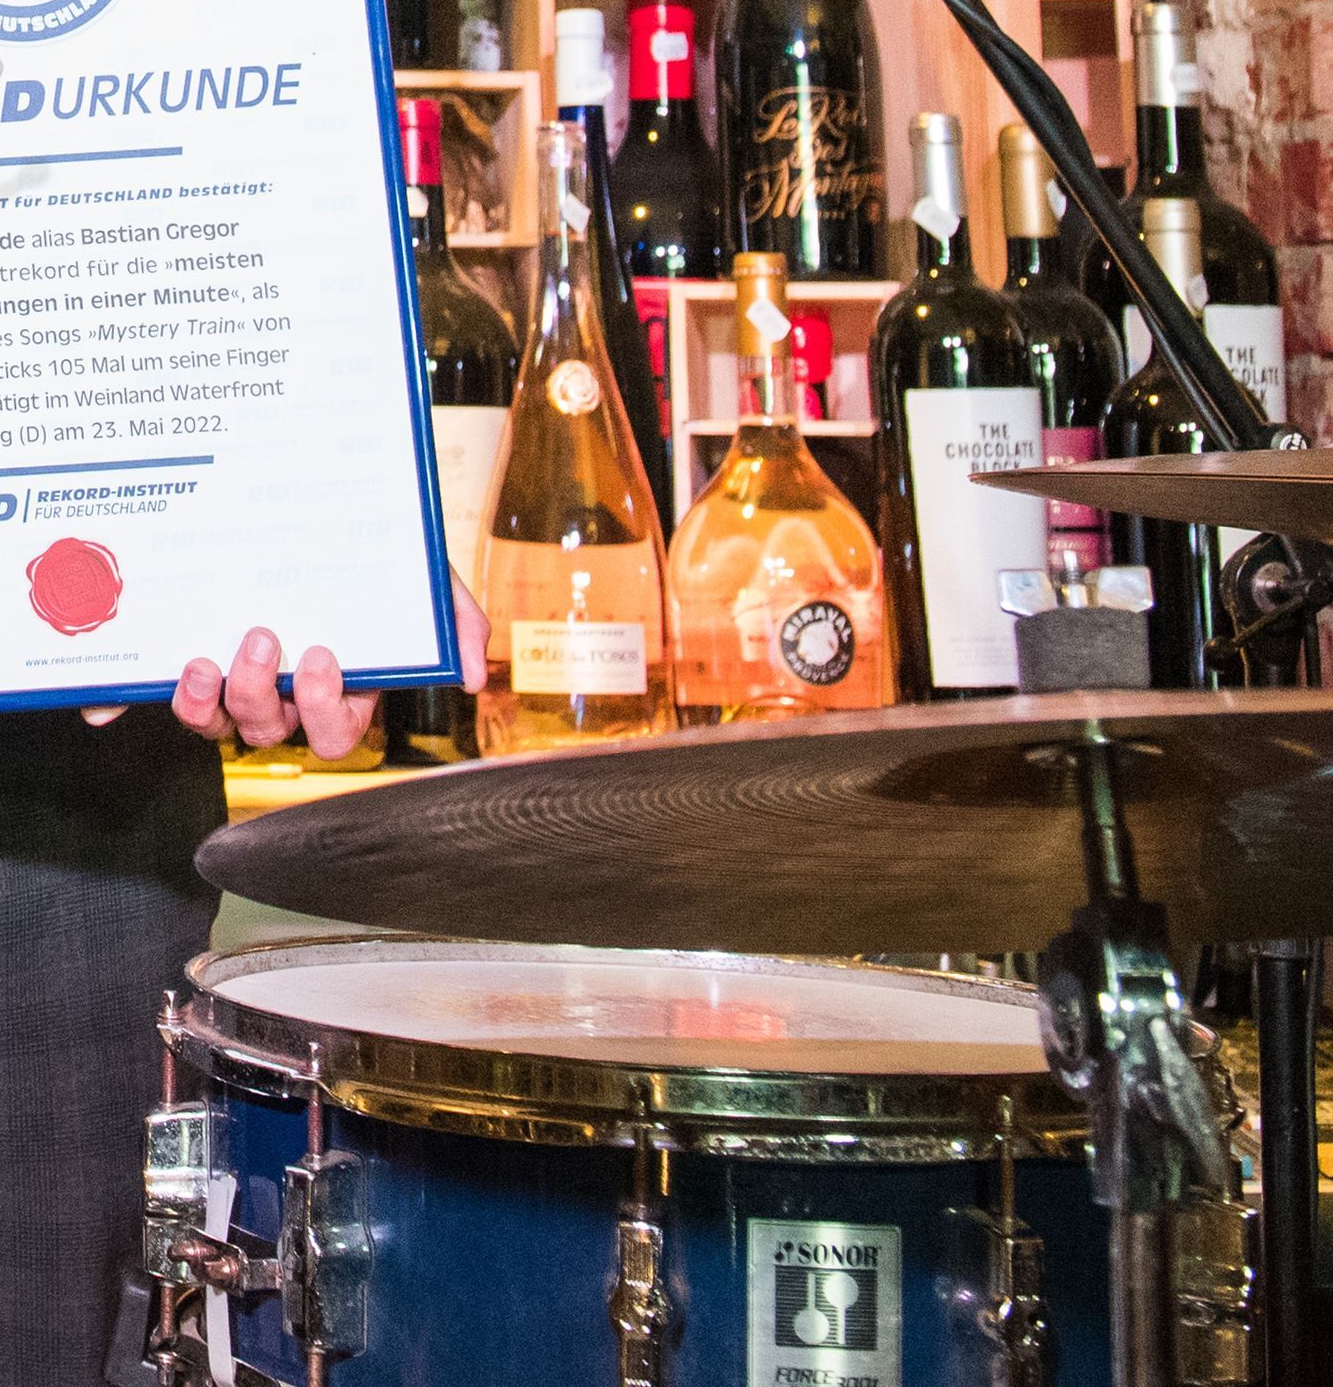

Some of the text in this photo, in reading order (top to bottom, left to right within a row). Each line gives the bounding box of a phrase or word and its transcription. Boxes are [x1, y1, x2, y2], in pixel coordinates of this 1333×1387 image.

[14, 196, 43, 209] für
[47, 187, 173, 206] DEUTSCHLAND
[178, 181, 273, 198] bestätigt:
[31, 229, 76, 249] alias
[80, 224, 160, 246] Bastian
[165, 222, 240, 241] Gregor
[86, 259, 120, 277] für
[126, 256, 158, 275] die
[64, 293, 84, 311] in
[90, 291, 147, 310] einer
[252, 281, 280, 300] als
[19, 328, 82, 347] Songs
[252, 316, 291, 332] von
[48, 357, 86, 377] 105
[91, 354, 126, 374] Mal
[131, 356, 163, 372] um
[169, 350, 221, 370] seine
[226, 347, 290, 367] Finger
[1225, 346, 1256, 364] THE
[44, 391, 69, 409] im
[73, 384, 165, 407] Weinland
[169, 379, 285, 402] Waterfront
[19, 424, 47, 446] (D)
[53, 425, 85, 442] am
[91, 421, 123, 439] 23.
[129, 417, 164, 437] Mai
[171, 414, 228, 435] 2022.
[979, 423, 1009, 440] THE
[945, 441, 1035, 459] CHOCOLATE
[37, 481, 198, 504] REKORD-INSTITUT
[34, 499, 168, 520] FÜR DEUTSCHLAND
[782, 605, 852, 643] MIRAVAL
[25, 652, 139, 667] www.rekord-institut.org
[797, 1242, 879, 1268] SONOR
[774, 1366, 836, 1385] FORCE
